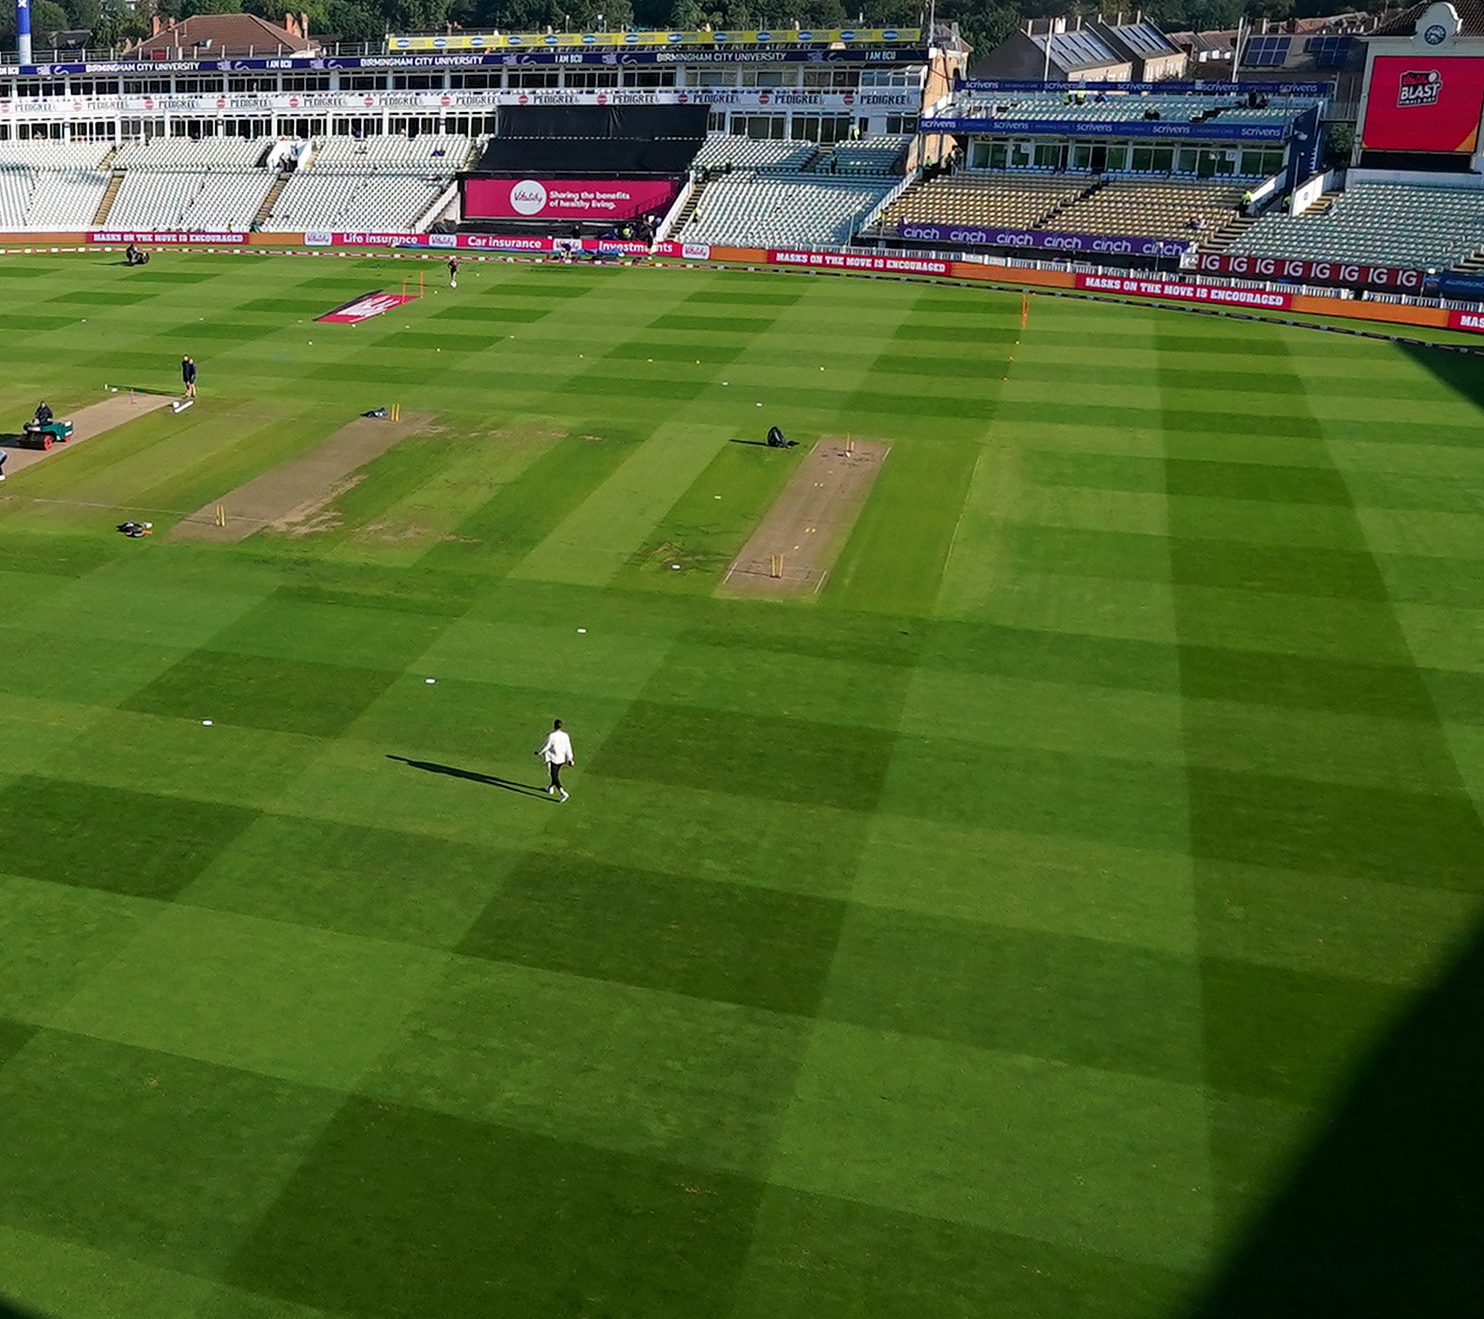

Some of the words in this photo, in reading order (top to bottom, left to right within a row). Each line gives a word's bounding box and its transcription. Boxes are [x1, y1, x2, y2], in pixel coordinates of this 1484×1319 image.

[360, 57, 413, 67] BIRMINGHAM
[414, 57, 433, 67] CITY
[434, 55, 484, 65] UNIVERSITY
[559, 55, 569, 63] AM
[656, 53, 712, 62] BIRMINGHAM
[714, 52, 733, 61] CITY
[735, 52, 786, 61] UNIVERSITY
[869, 52, 880, 60] AM
[86, 62, 136, 72] BIRMINGHAM
[137, 62, 154, 71] CITY
[156, 61, 199, 71] UNIVERSITY
[965, 81, 999, 89] scrivens
[1400, 83, 1440, 100] BLAST
[693, 95, 734, 104] PEDIGREE
[775, 95, 819, 104] PEDIGREE
[860, 96, 907, 105] PEDIGREE
[921, 120, 956, 128] scrivens
[993, 121, 1029, 130] scrivens
[1241, 127, 1280, 137] scrivens
[549, 191, 579, 201] Sharing
[581, 191, 594, 199] the
[596, 191, 630, 200] benefits
[560, 200, 590, 209] healthy
[591, 200, 616, 209] living.
[343, 234, 364, 244] Life
[366, 234, 417, 244] insurance
[903, 227, 939, 240] cinch
[950, 228, 987, 242] cinch
[996, 231, 1033, 246] cinch
[468, 236, 487, 246] Car
[489, 238, 542, 249] insurance
[1044, 234, 1082, 249] cinch
[1092, 238, 1132, 253] cinch
[1142, 241, 1182, 256] cinch
[1202, 255, 1220, 270] IG
[1229, 257, 1247, 273] IG
[1255, 259, 1275, 275] IG
[1284, 260, 1304, 277] IG
[1310, 262, 1330, 279] IG
[1340, 265, 1359, 281] IG
[1368, 267, 1388, 284] IG
[1396, 270, 1417, 287] IG
[1085, 277, 1121, 291] MASKS
[1123, 280, 1138, 292] ON
[1140, 281, 1162, 294] THE
[1163, 284, 1194, 297] MOVE
[1196, 287, 1207, 298] IS
[1210, 289, 1284, 305] ENCOURAGED
